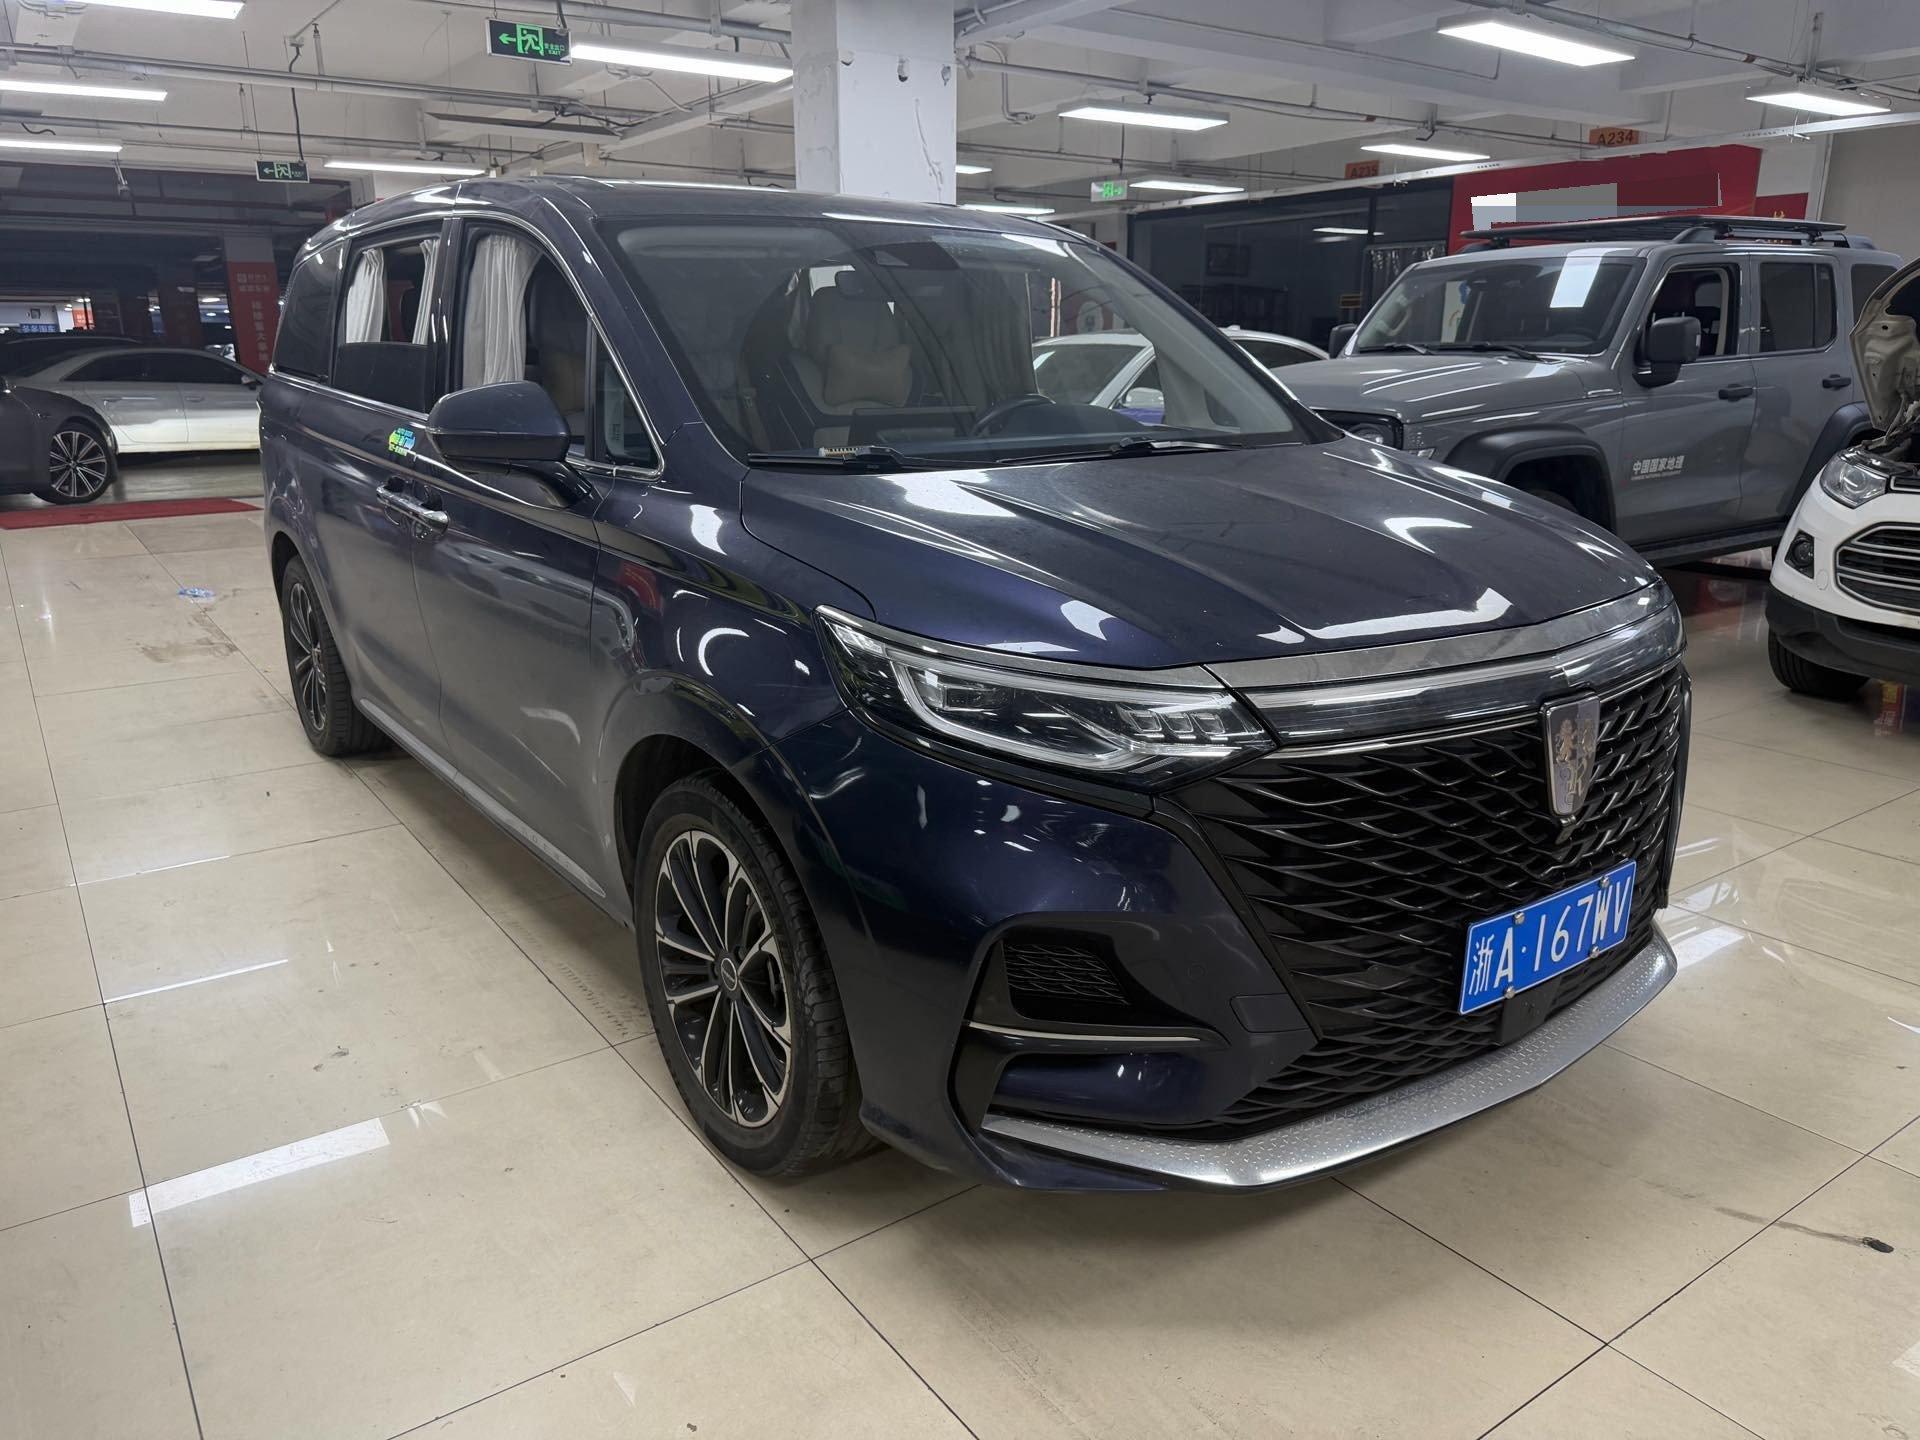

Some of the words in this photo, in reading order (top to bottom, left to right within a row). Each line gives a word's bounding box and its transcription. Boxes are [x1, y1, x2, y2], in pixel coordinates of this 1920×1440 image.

[1598, 129, 1633, 145] A234
[1632, 455, 1685, 475] 中国国家地理
